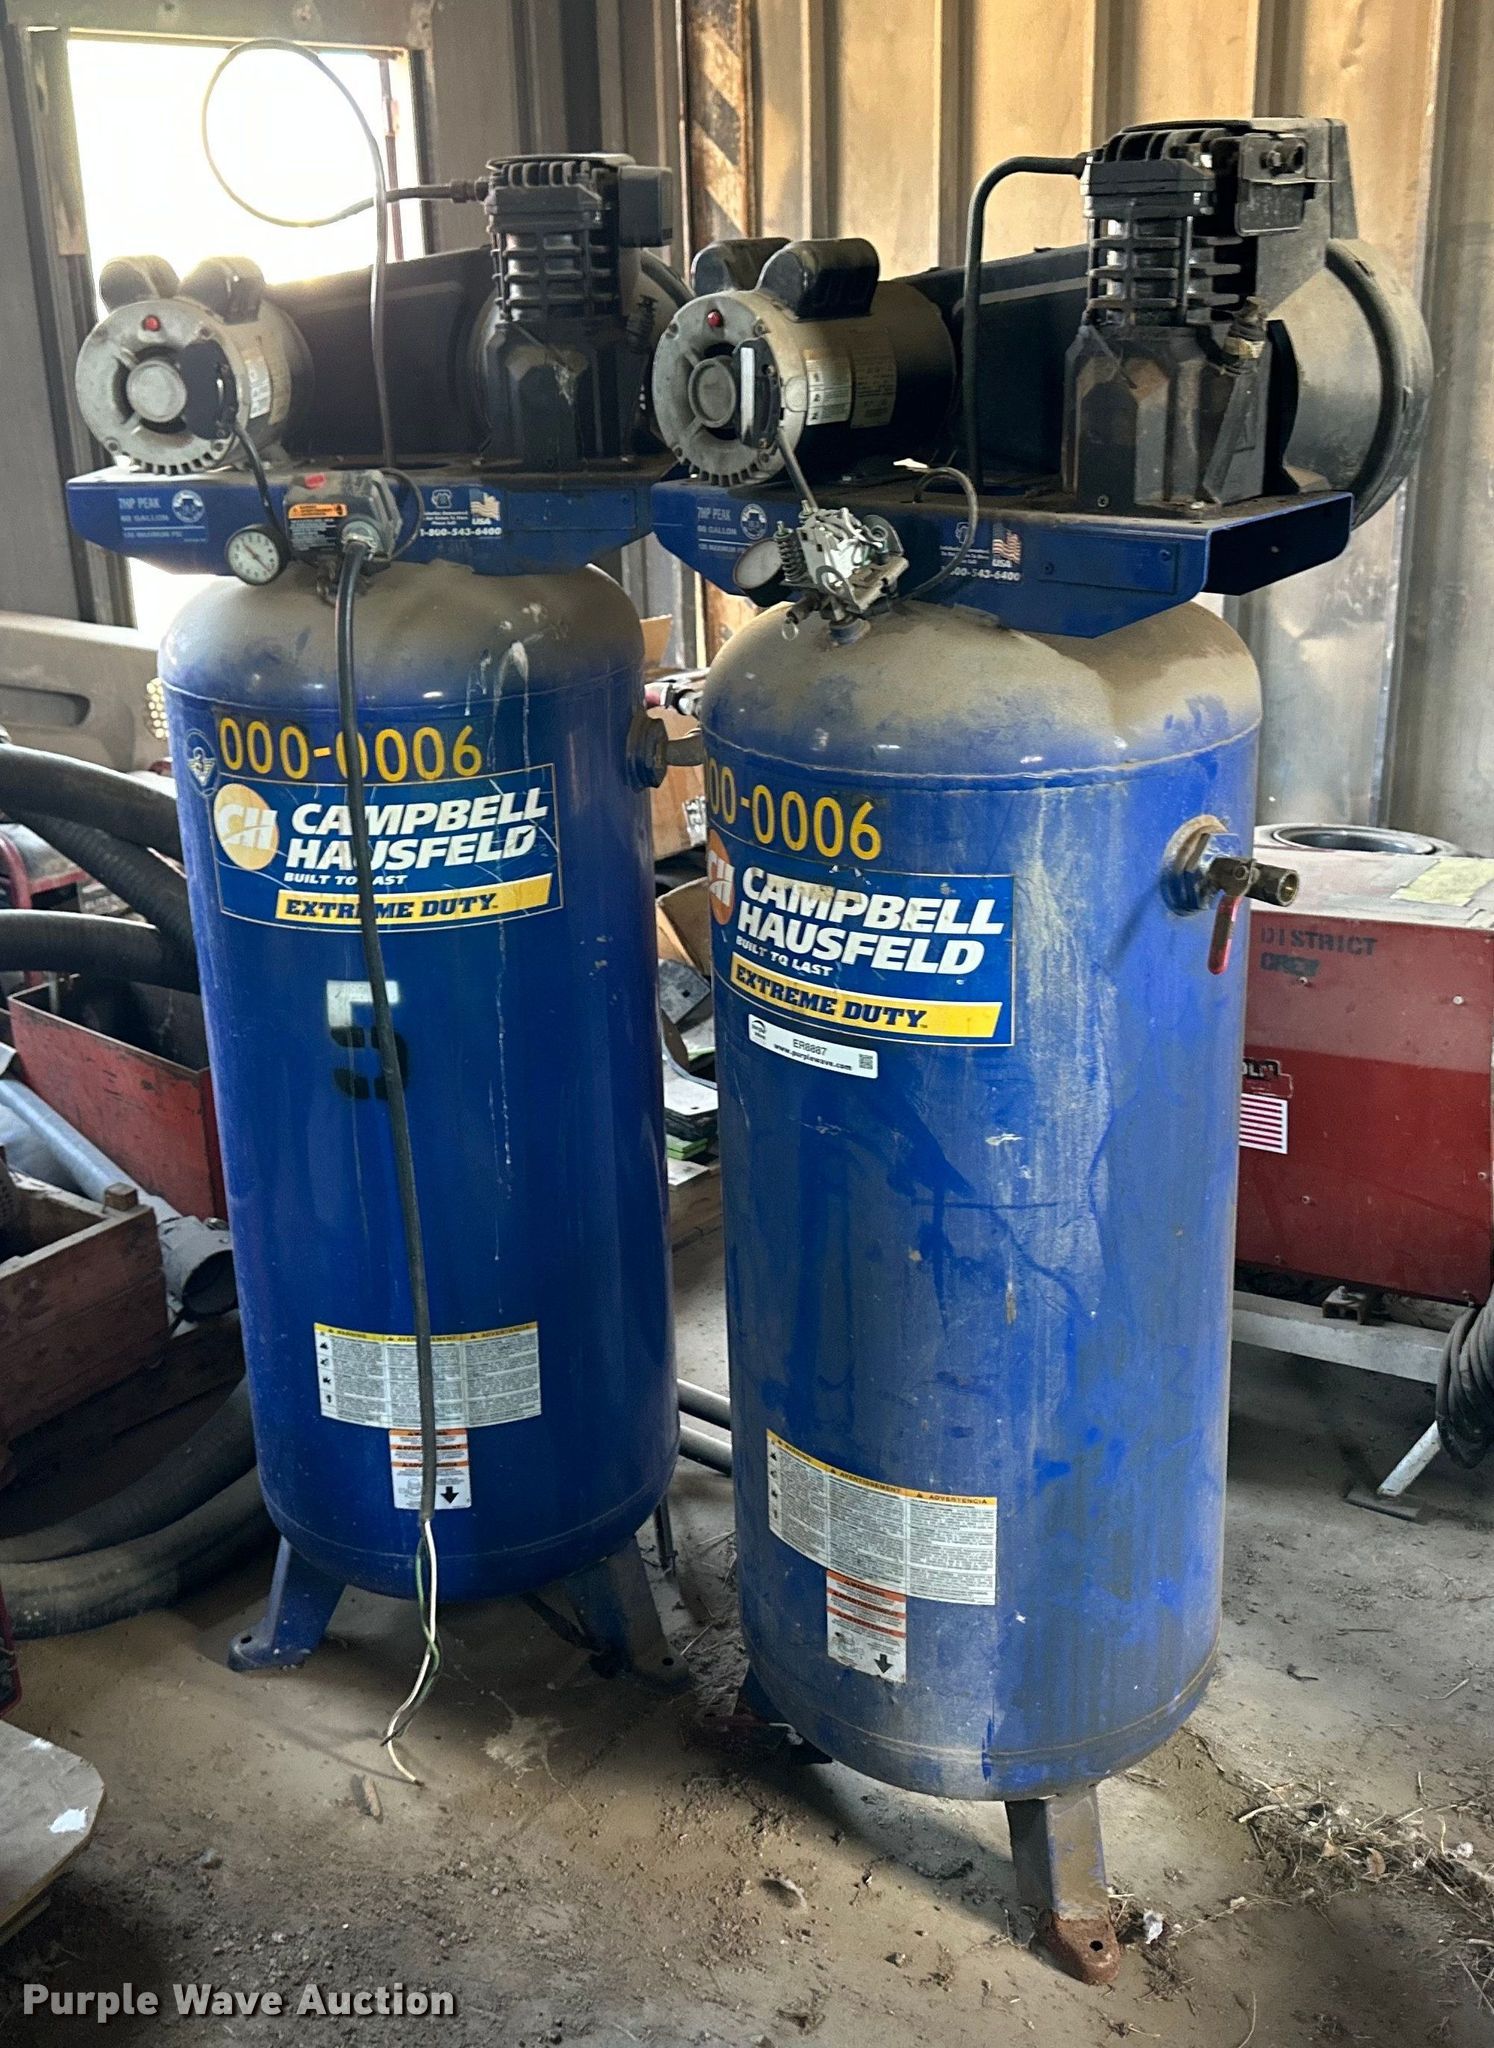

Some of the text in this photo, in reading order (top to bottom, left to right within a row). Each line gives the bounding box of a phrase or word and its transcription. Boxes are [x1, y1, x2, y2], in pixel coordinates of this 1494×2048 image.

[420, 527, 502, 537] 1-800-543-6400
[992, 559, 1012, 568] USA
[219, 716, 482, 783] 000-0006
[291, 786, 549, 836] CAMPBELL
[706, 755, 881, 860] 00-0006
[284, 873, 408, 886] BUILT TO AST
[285, 893, 497, 919] EXTRME DUTY
[742, 867, 1004, 934] CAMPBELL
[738, 900, 985, 975] HAUSFELD
[1260, 927, 1377, 956] DISTRICT
[736, 935, 768, 957] BUILT
[791, 958, 834, 976] LAST
[736, 962, 927, 1028] EXTREME DUTY
[774, 1043, 852, 1071] www.purplewave.com
[929, 1494, 988, 1504] ADVERTENCIA
